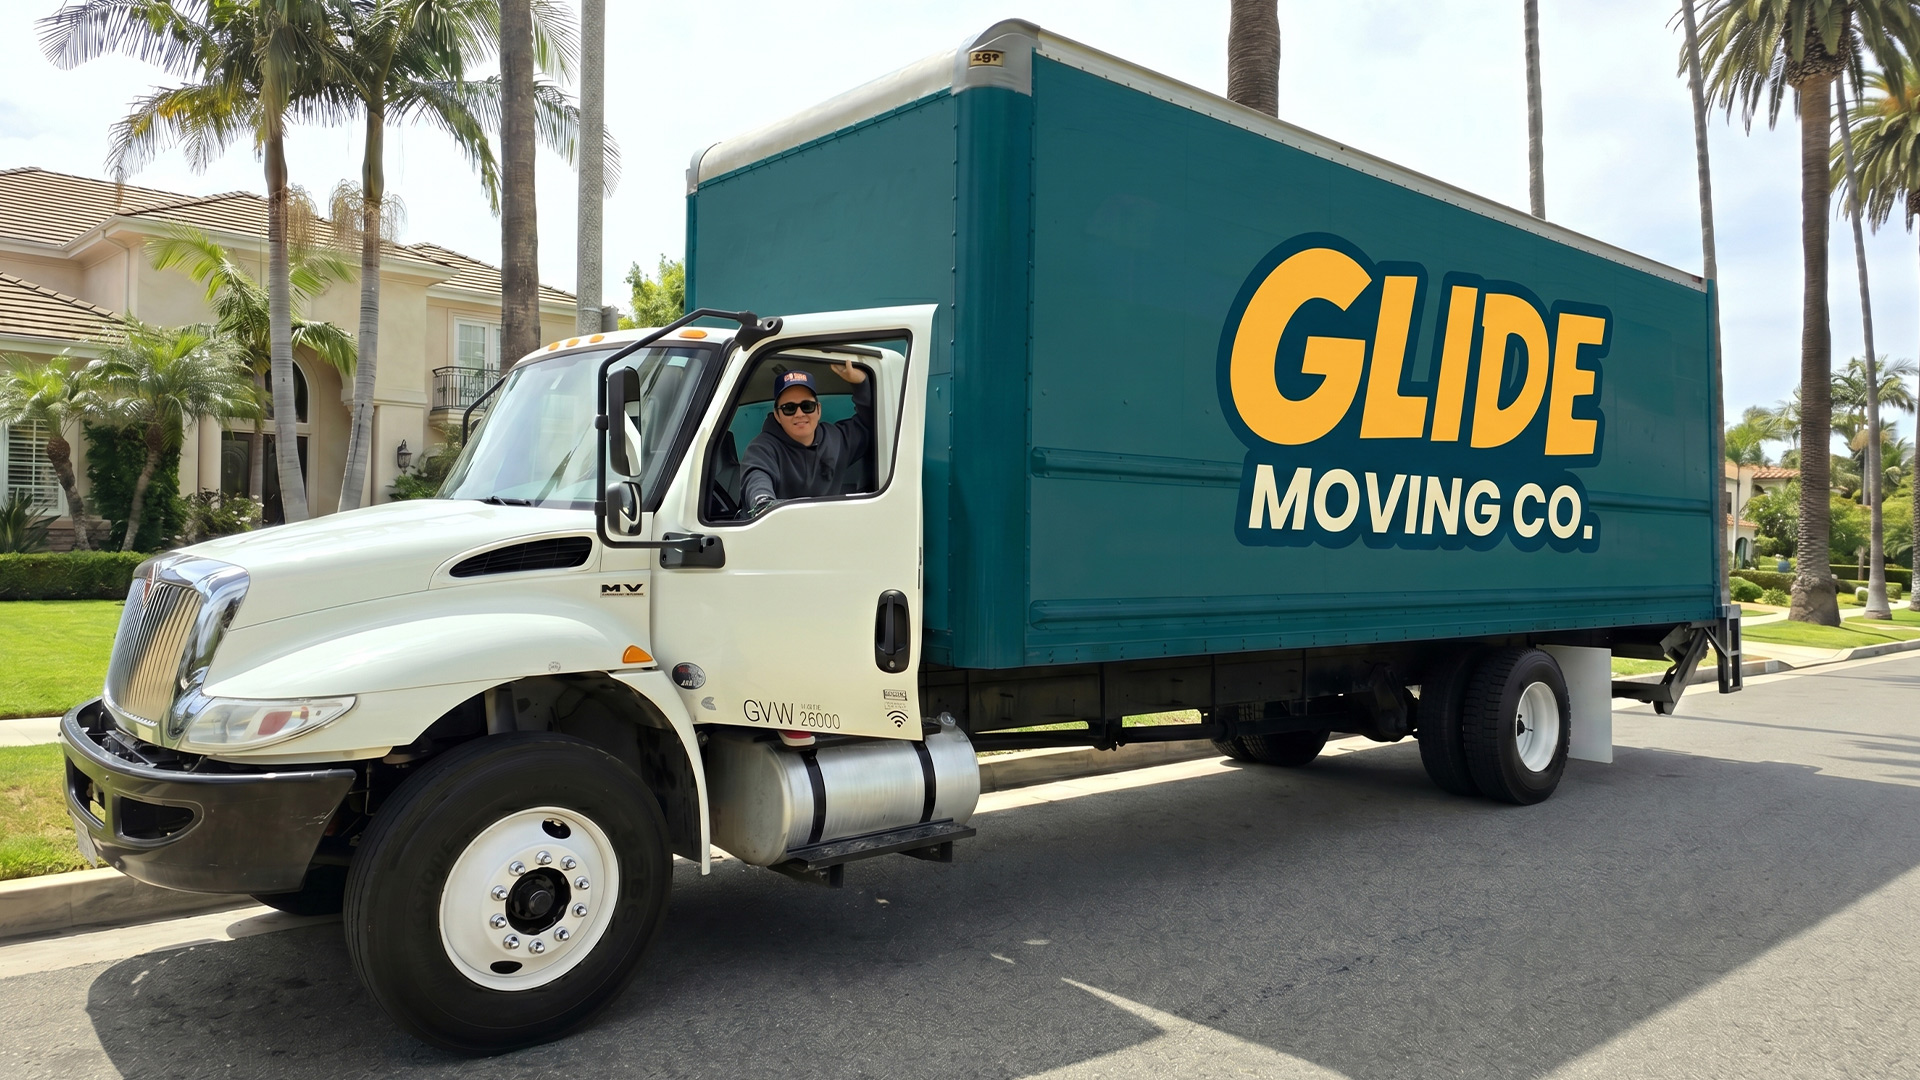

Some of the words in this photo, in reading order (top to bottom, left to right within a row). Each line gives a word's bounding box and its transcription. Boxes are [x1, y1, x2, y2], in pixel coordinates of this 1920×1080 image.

[1230, 247, 1606, 456] GLIDE
[1248, 464, 1501, 537] MOVING
[1513, 483, 1593, 540] CO.
[601, 584, 644, 593] MV
[743, 699, 794, 726] GVW
[800, 711, 840, 730] 26000
